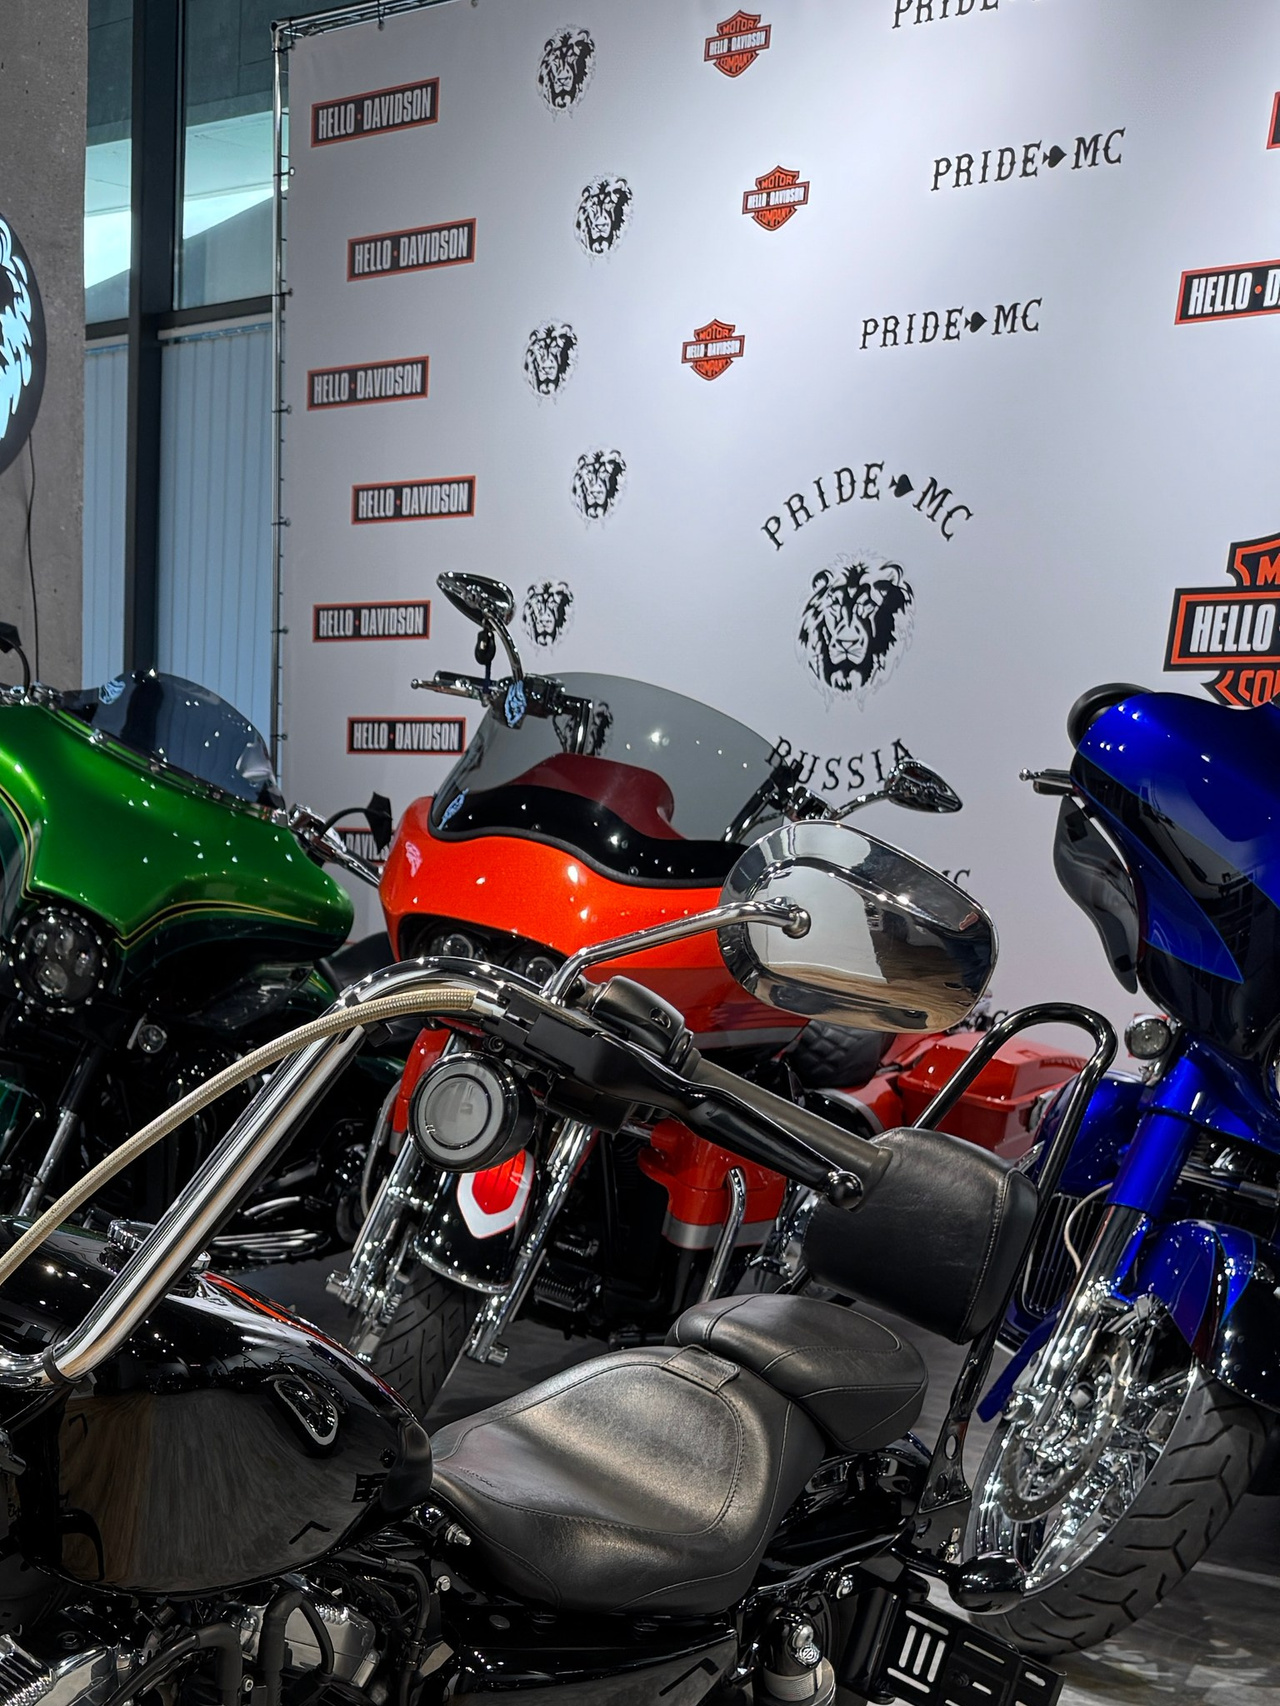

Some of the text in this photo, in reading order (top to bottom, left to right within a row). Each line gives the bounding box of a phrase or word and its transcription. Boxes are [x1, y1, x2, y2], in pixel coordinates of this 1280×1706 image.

[723, 17, 754, 34] MOTOR
[731, 31, 766, 51] DAVIDSON
[720, 53, 752, 72] COMPANY
[318, 87, 432, 140] HELLO DAVIDSON
[930, 127, 1126, 191] PRIDE MC
[761, 172, 793, 188] MOTOR
[758, 207, 790, 226] COMPANY
[354, 226, 469, 274] HELLO DAVIDSON
[1187, 271, 1253, 316] HELLO
[699, 324, 729, 340] MOTOR
[859, 298, 1042, 350] PRIDE MC
[313, 362, 422, 404] HELLO DAVIDSON
[358, 482, 469, 519] HELLO DAVIDSON
[760, 460, 974, 551] PRIDE MC
[319, 606, 424, 637] HELLO DAVIDSON
[1189, 604, 1276, 653] HELLO
[353, 722, 460, 751] HELLO DAVIDSON
[765, 736, 914, 792] RUSSIA
